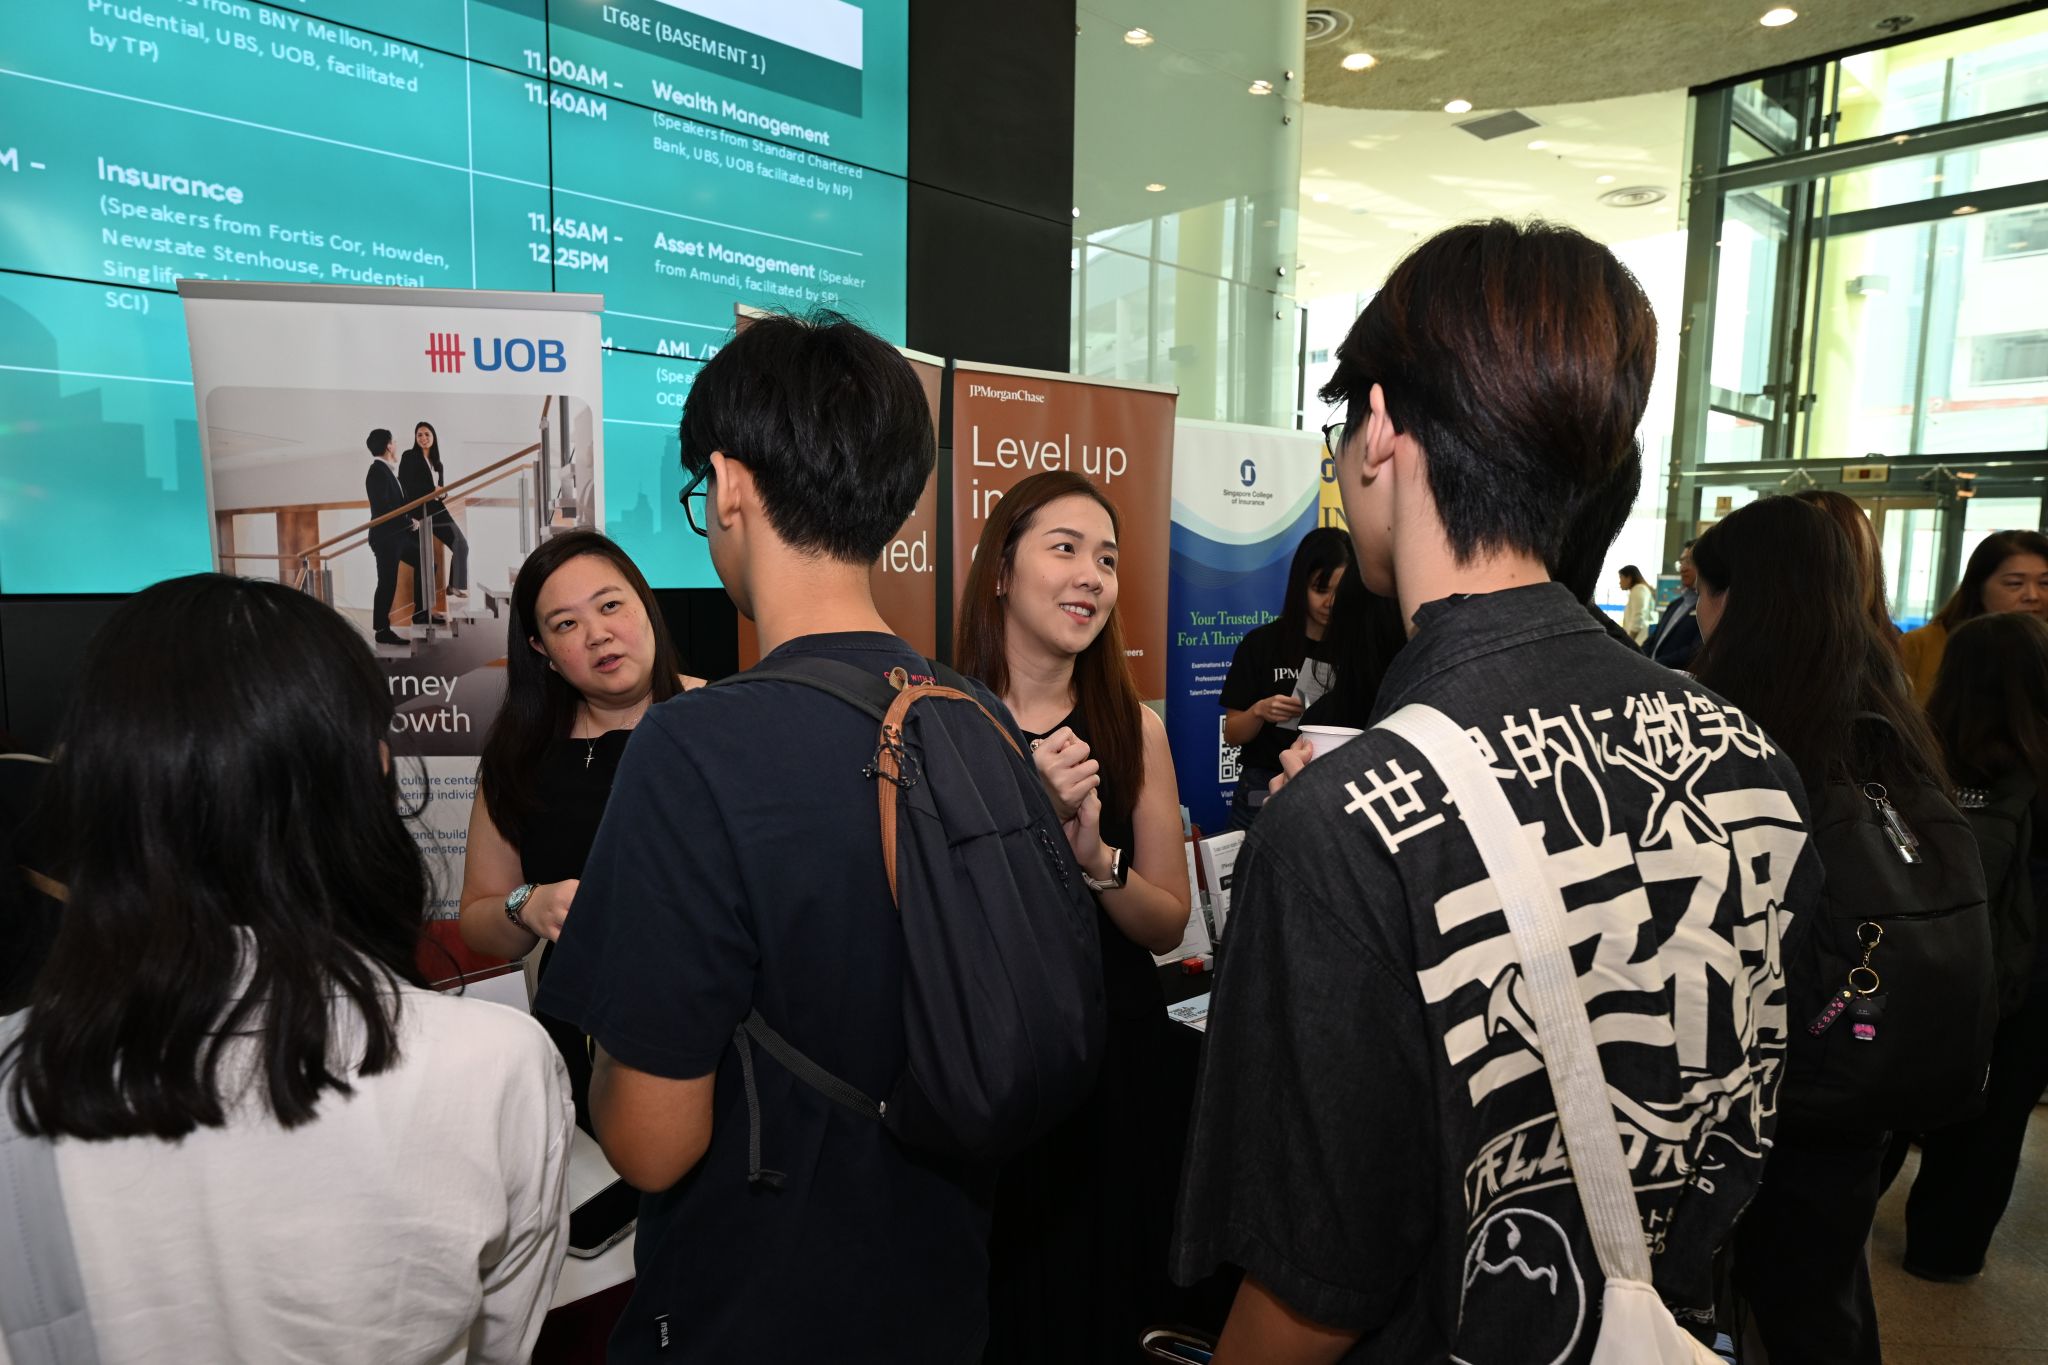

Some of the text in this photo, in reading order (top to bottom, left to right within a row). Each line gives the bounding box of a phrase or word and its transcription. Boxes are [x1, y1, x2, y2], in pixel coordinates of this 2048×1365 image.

[88, 0, 418, 92] Prudential, UBS, UOB, facilitated
[89, 26, 158, 63] by TP)
[259, 8, 299, 32] BNY
[307, 21, 377, 56] Mellon,
[382, 42, 424, 68] JPM,
[603, 5, 766, 75] LT68E (BASEMENT 1)
[523, 50, 608, 90] 11.00AM
[524, 83, 607, 121] 11.40AM
[652, 79, 830, 146] Wealth Management
[653, 111, 863, 180] (Speakers from Standard Chartered
[98, 156, 244, 204] Insurance
[654, 137, 853, 200] Bank, UBS, UOB facilitated by NP)
[101, 195, 449, 270] (Speakers from Fortis Cor, Howden,
[528, 212, 608, 244] 11.45AM
[102, 228, 424, 287] Newstate Stenhouse, Prudential
[529, 243, 608, 273] 12.25PM
[654, 231, 865, 288] Asset Management (Speaker
[655, 259, 686, 278] from
[689, 267, 742, 290] Amundi,
[745, 276, 802, 299] facilitated
[806, 287, 819, 302] by
[106, 291, 149, 315] SCI)
[473, 337, 567, 373] UOB
[656, 338, 695, 359] AML
[656, 367, 697, 384] (Spea
[656, 392, 687, 407] OCB
[969, 384, 1045, 403] JPMorganChase
[972, 425, 1127, 483] Level up
[1223, 489, 1273, 499] Singapore College
[1238, 498, 1265, 506] Insurance
[882, 530, 933, 573] ed.
[1190, 610, 1282, 626] Your Trusted Par
[1177, 631, 1243, 646] For A Thrivi
[1191, 661, 1220, 669] Examinations
[1274, 667, 1299, 682] JPM
[389, 675, 458, 703] rney
[390, 705, 471, 733] owth
[437, 790, 476, 800] individ
[444, 776, 480, 786] cente
